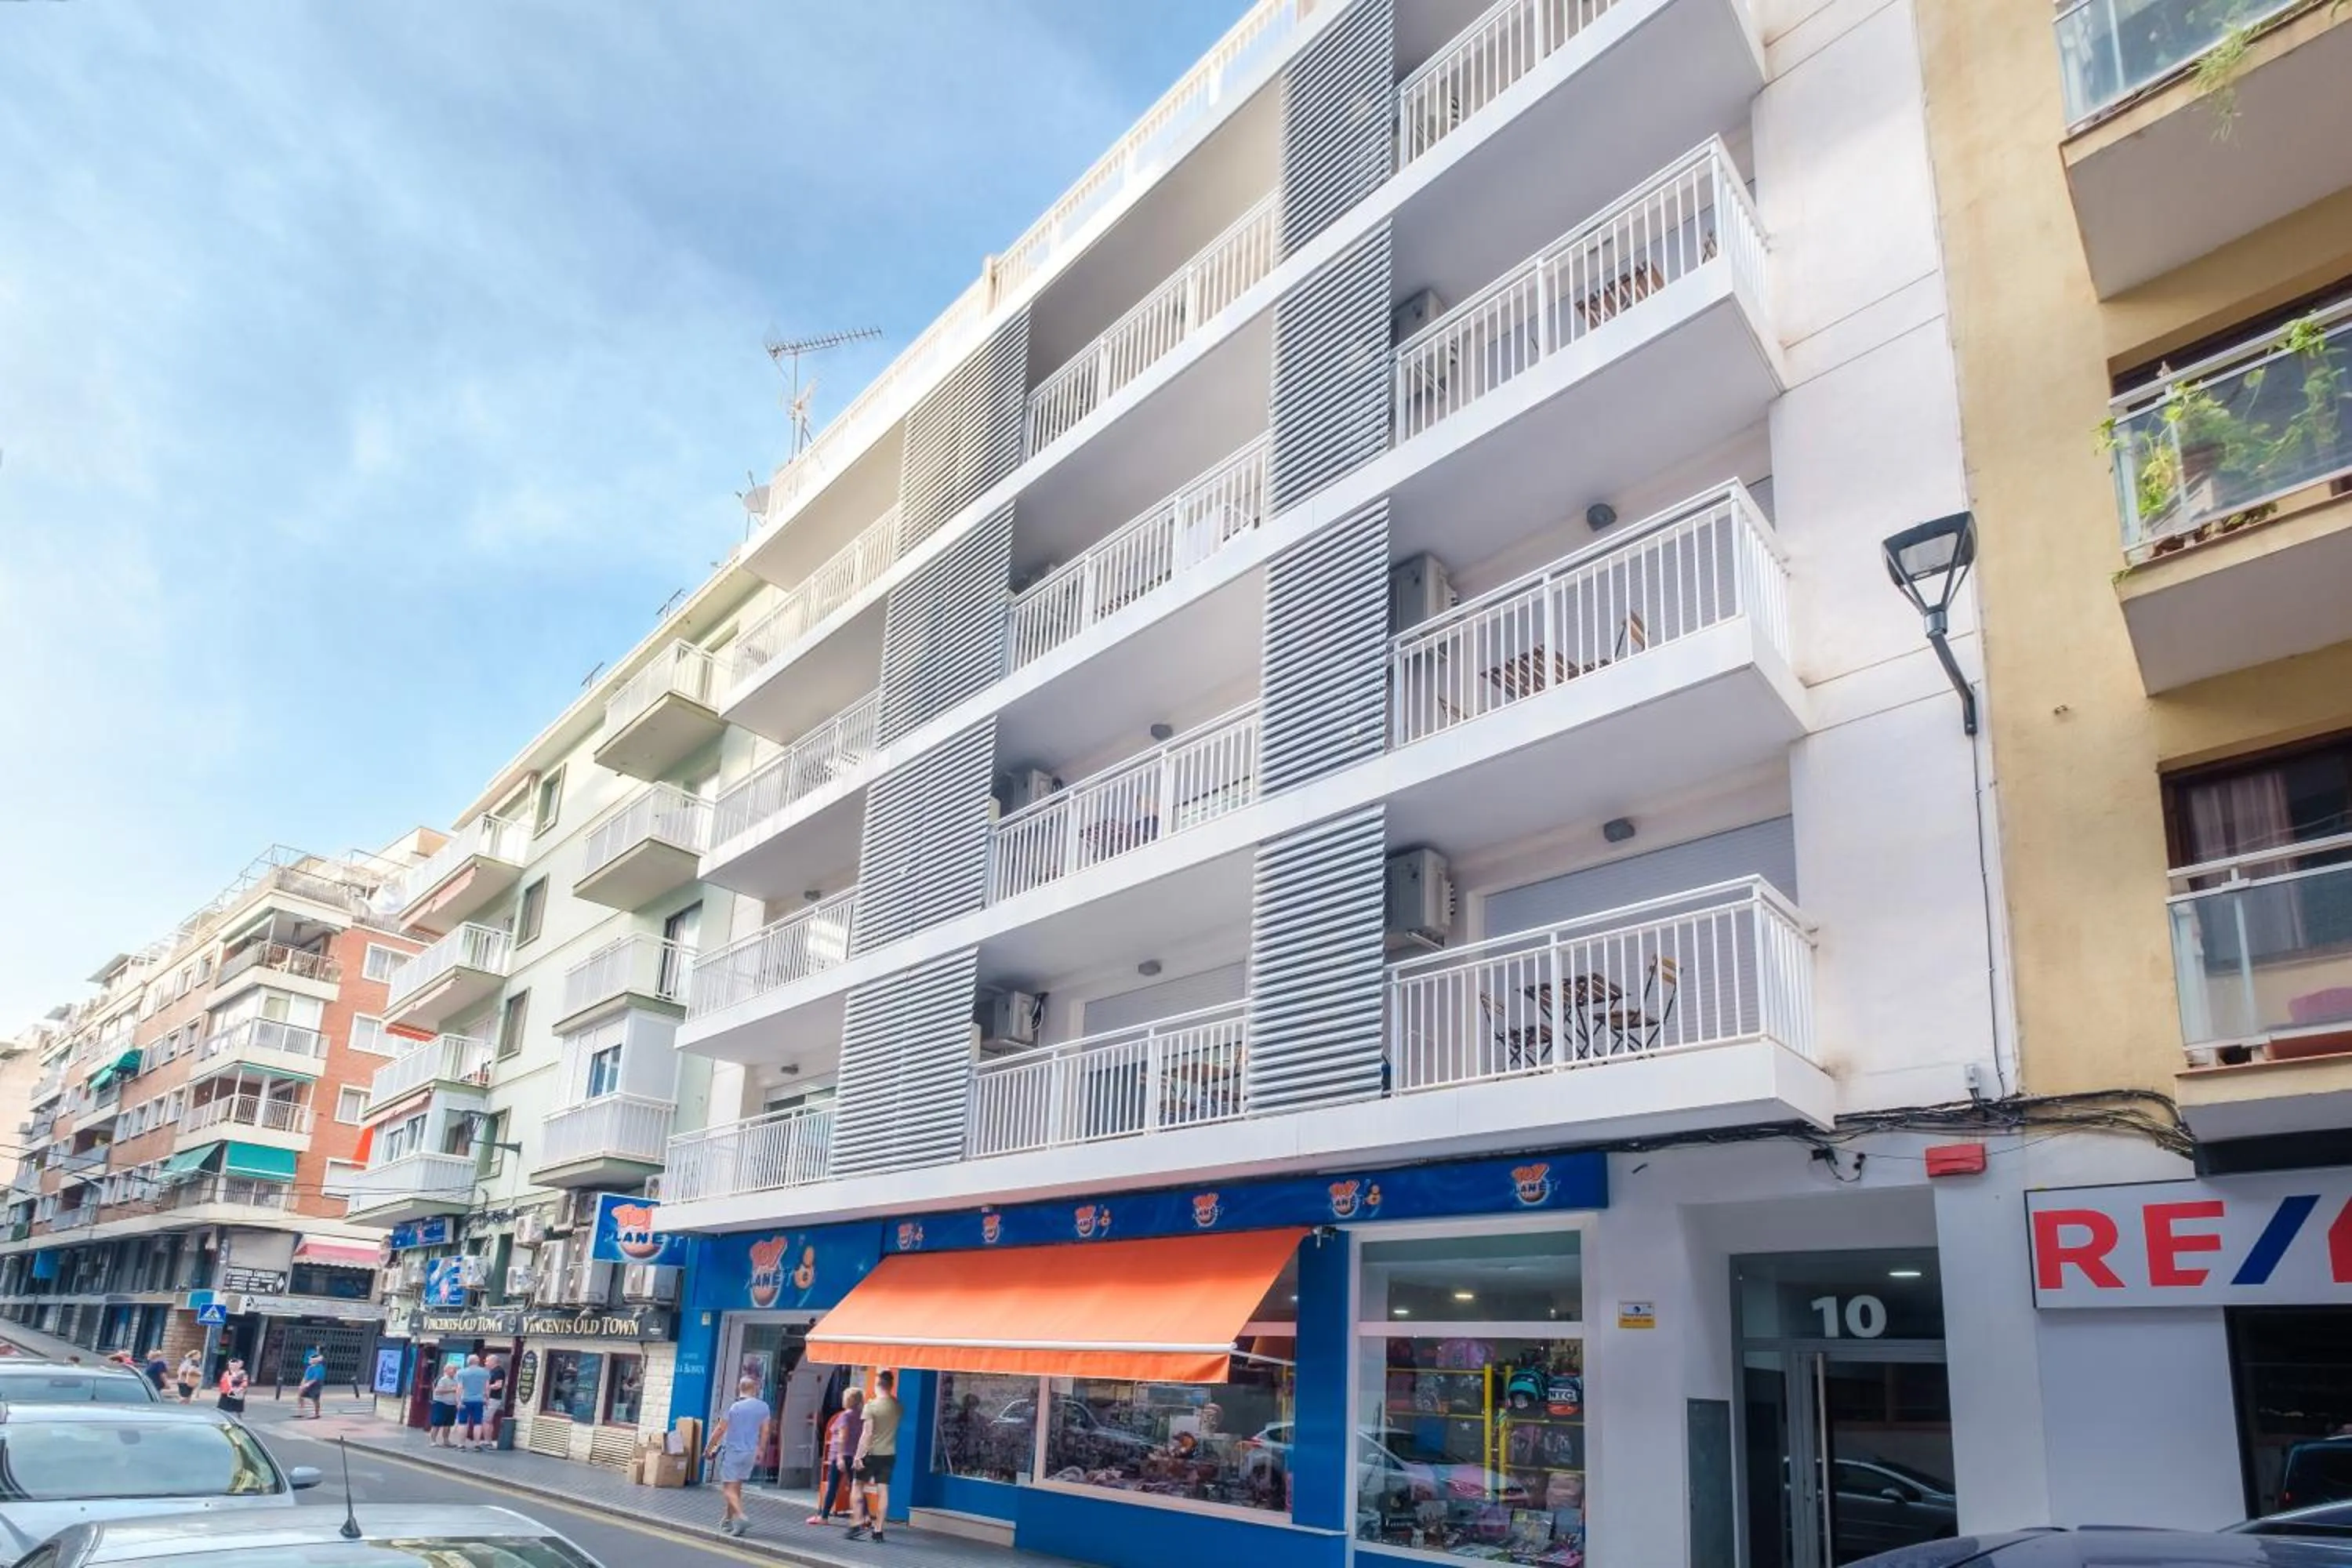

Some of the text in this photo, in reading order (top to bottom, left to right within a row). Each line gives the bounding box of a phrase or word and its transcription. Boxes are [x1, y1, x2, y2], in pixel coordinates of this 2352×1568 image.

[2033, 1193, 2352, 1290] RE/
[573, 1317, 600, 1334] OLD
[601, 1316, 640, 1335] TOWN
[1811, 1294, 1887, 1338] 10
